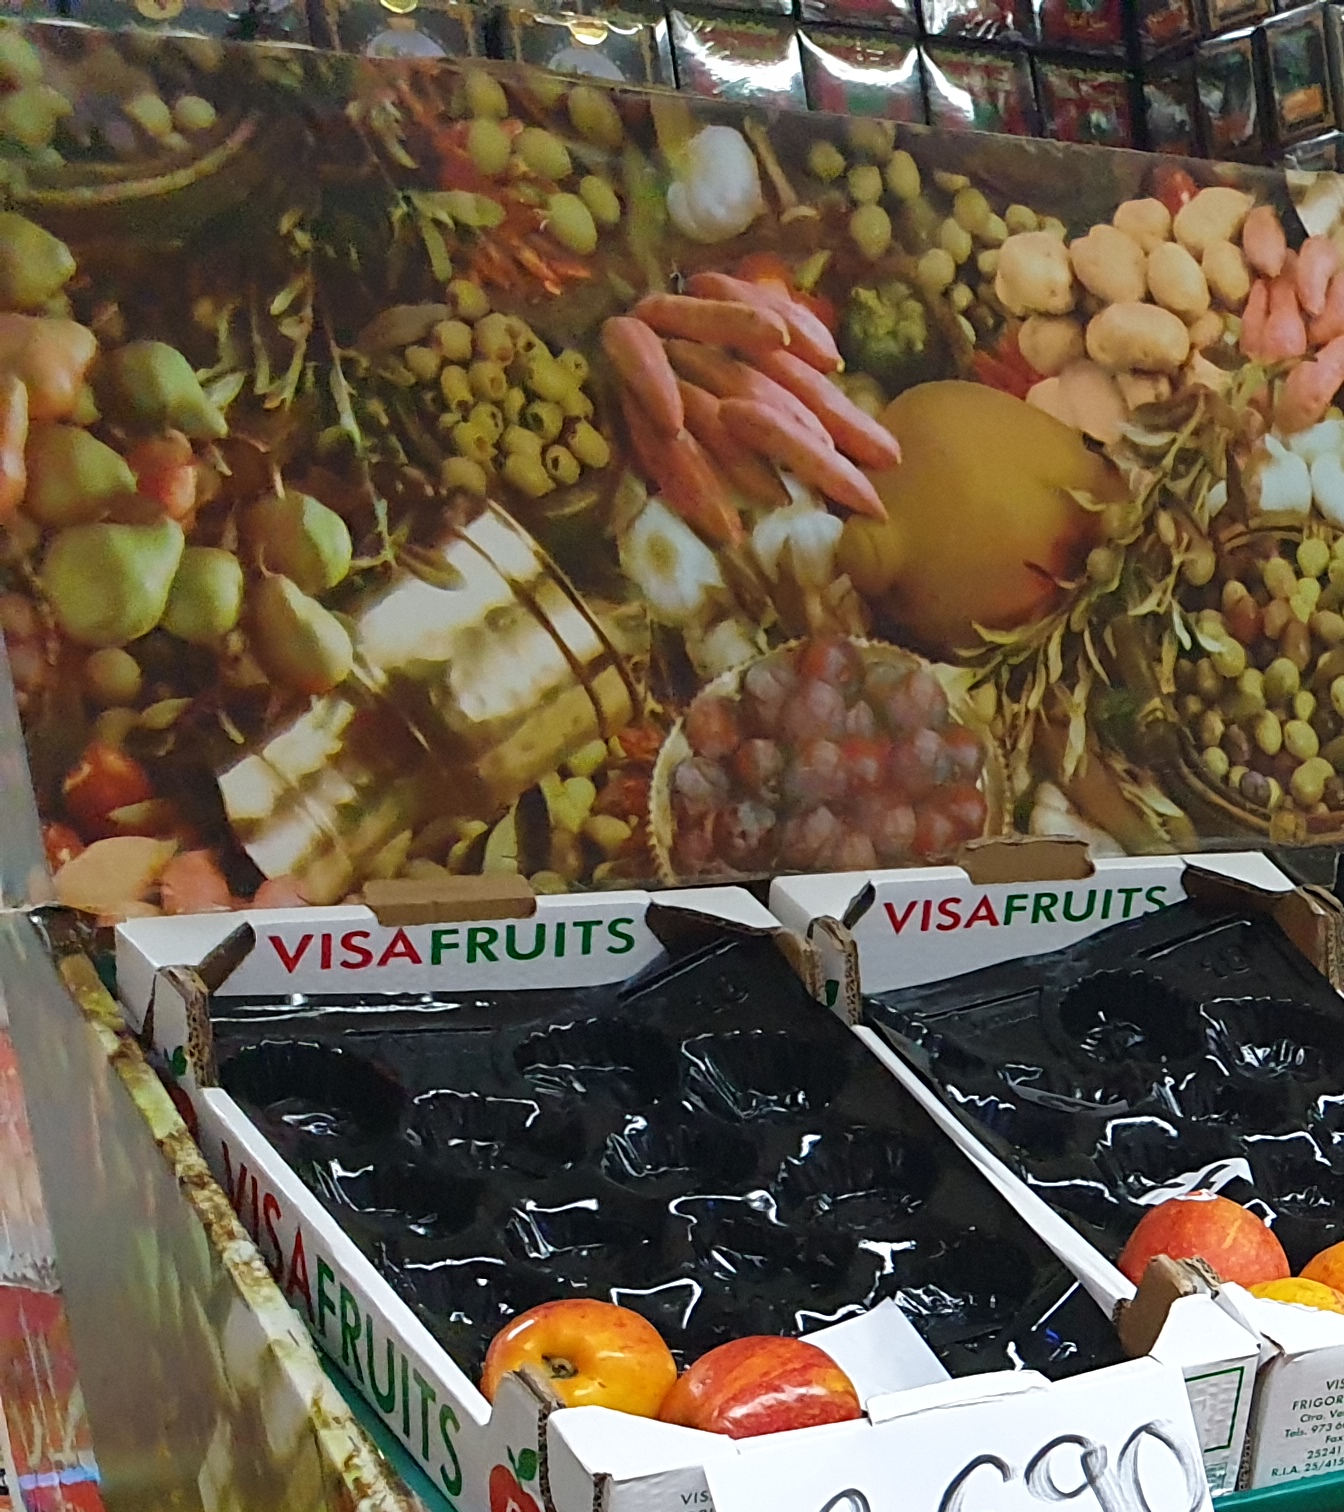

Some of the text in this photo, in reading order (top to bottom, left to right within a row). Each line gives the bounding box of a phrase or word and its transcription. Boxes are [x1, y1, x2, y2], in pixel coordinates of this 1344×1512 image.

[883, 884, 1168, 936] VISAFRUITS
[269, 916, 637, 973] VISAFRUITS
[1311, 1421, 1333, 1434] 973
[1306, 1445, 1342, 1460] 25241
[681, 1489, 712, 1505] VIS
